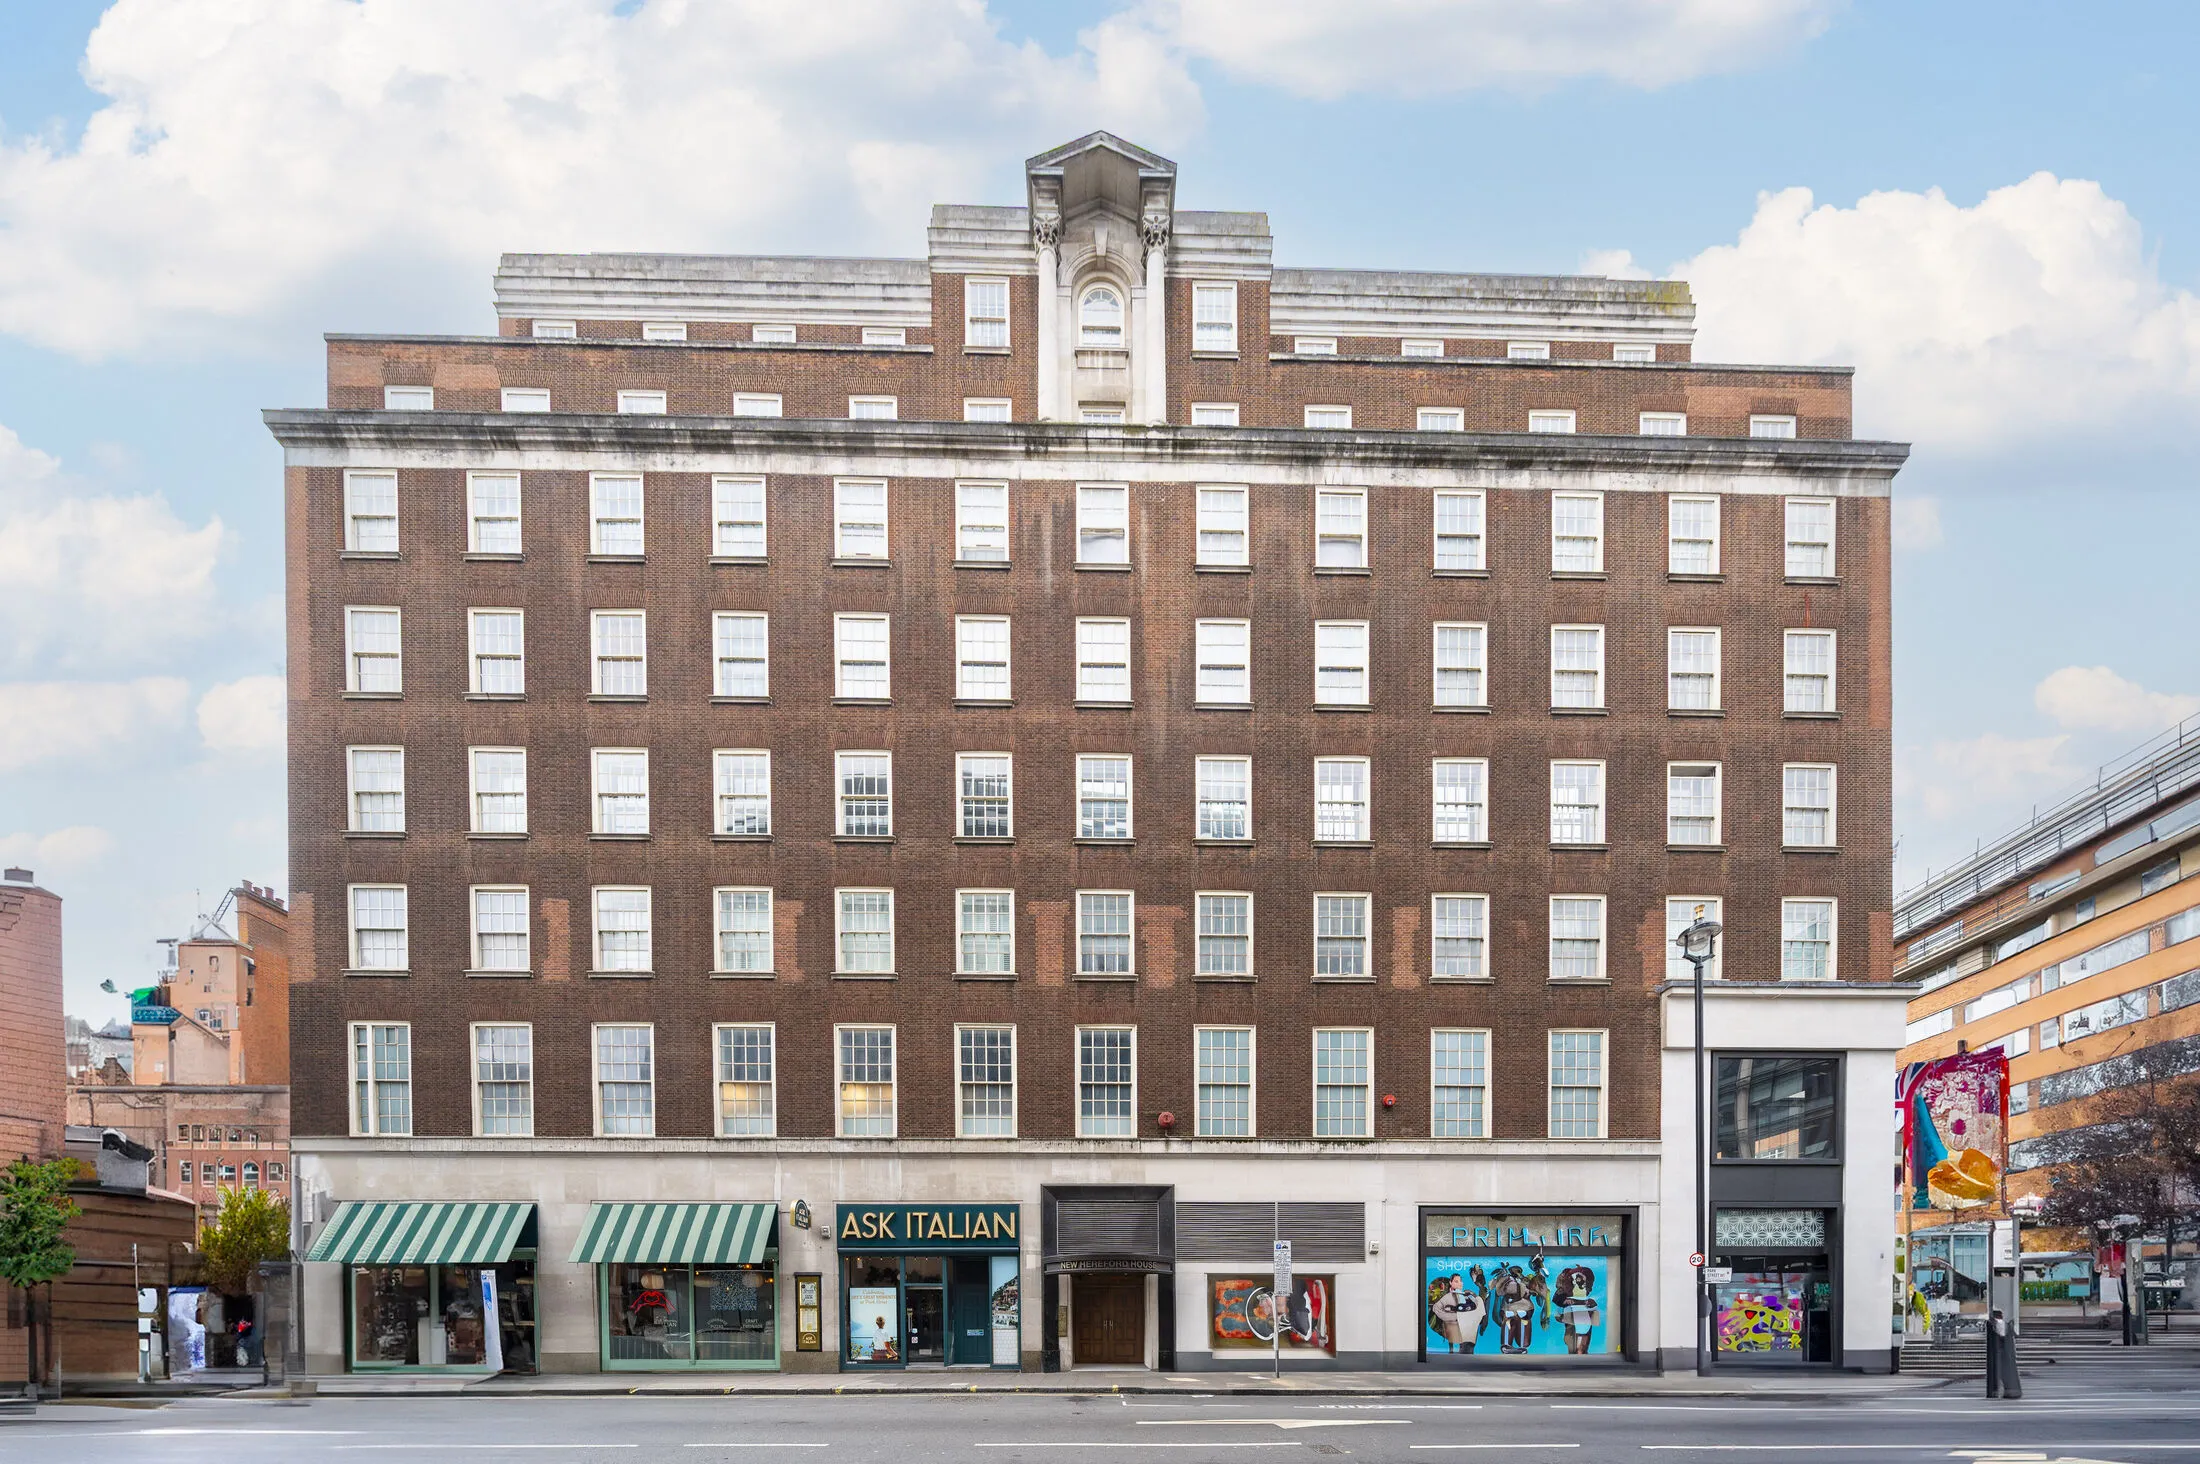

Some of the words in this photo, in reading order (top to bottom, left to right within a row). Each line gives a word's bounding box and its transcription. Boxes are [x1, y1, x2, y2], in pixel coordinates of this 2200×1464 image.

[841, 1212, 896, 1239] ASK
[906, 1212, 1016, 1239] ITALIAN
[1060, 1261, 1078, 1269] NEW
[1080, 1260, 1128, 1268] HEREFORD
[1130, 1261, 1157, 1269] HOUSE
[1436, 1260, 1472, 1271] SHOP
